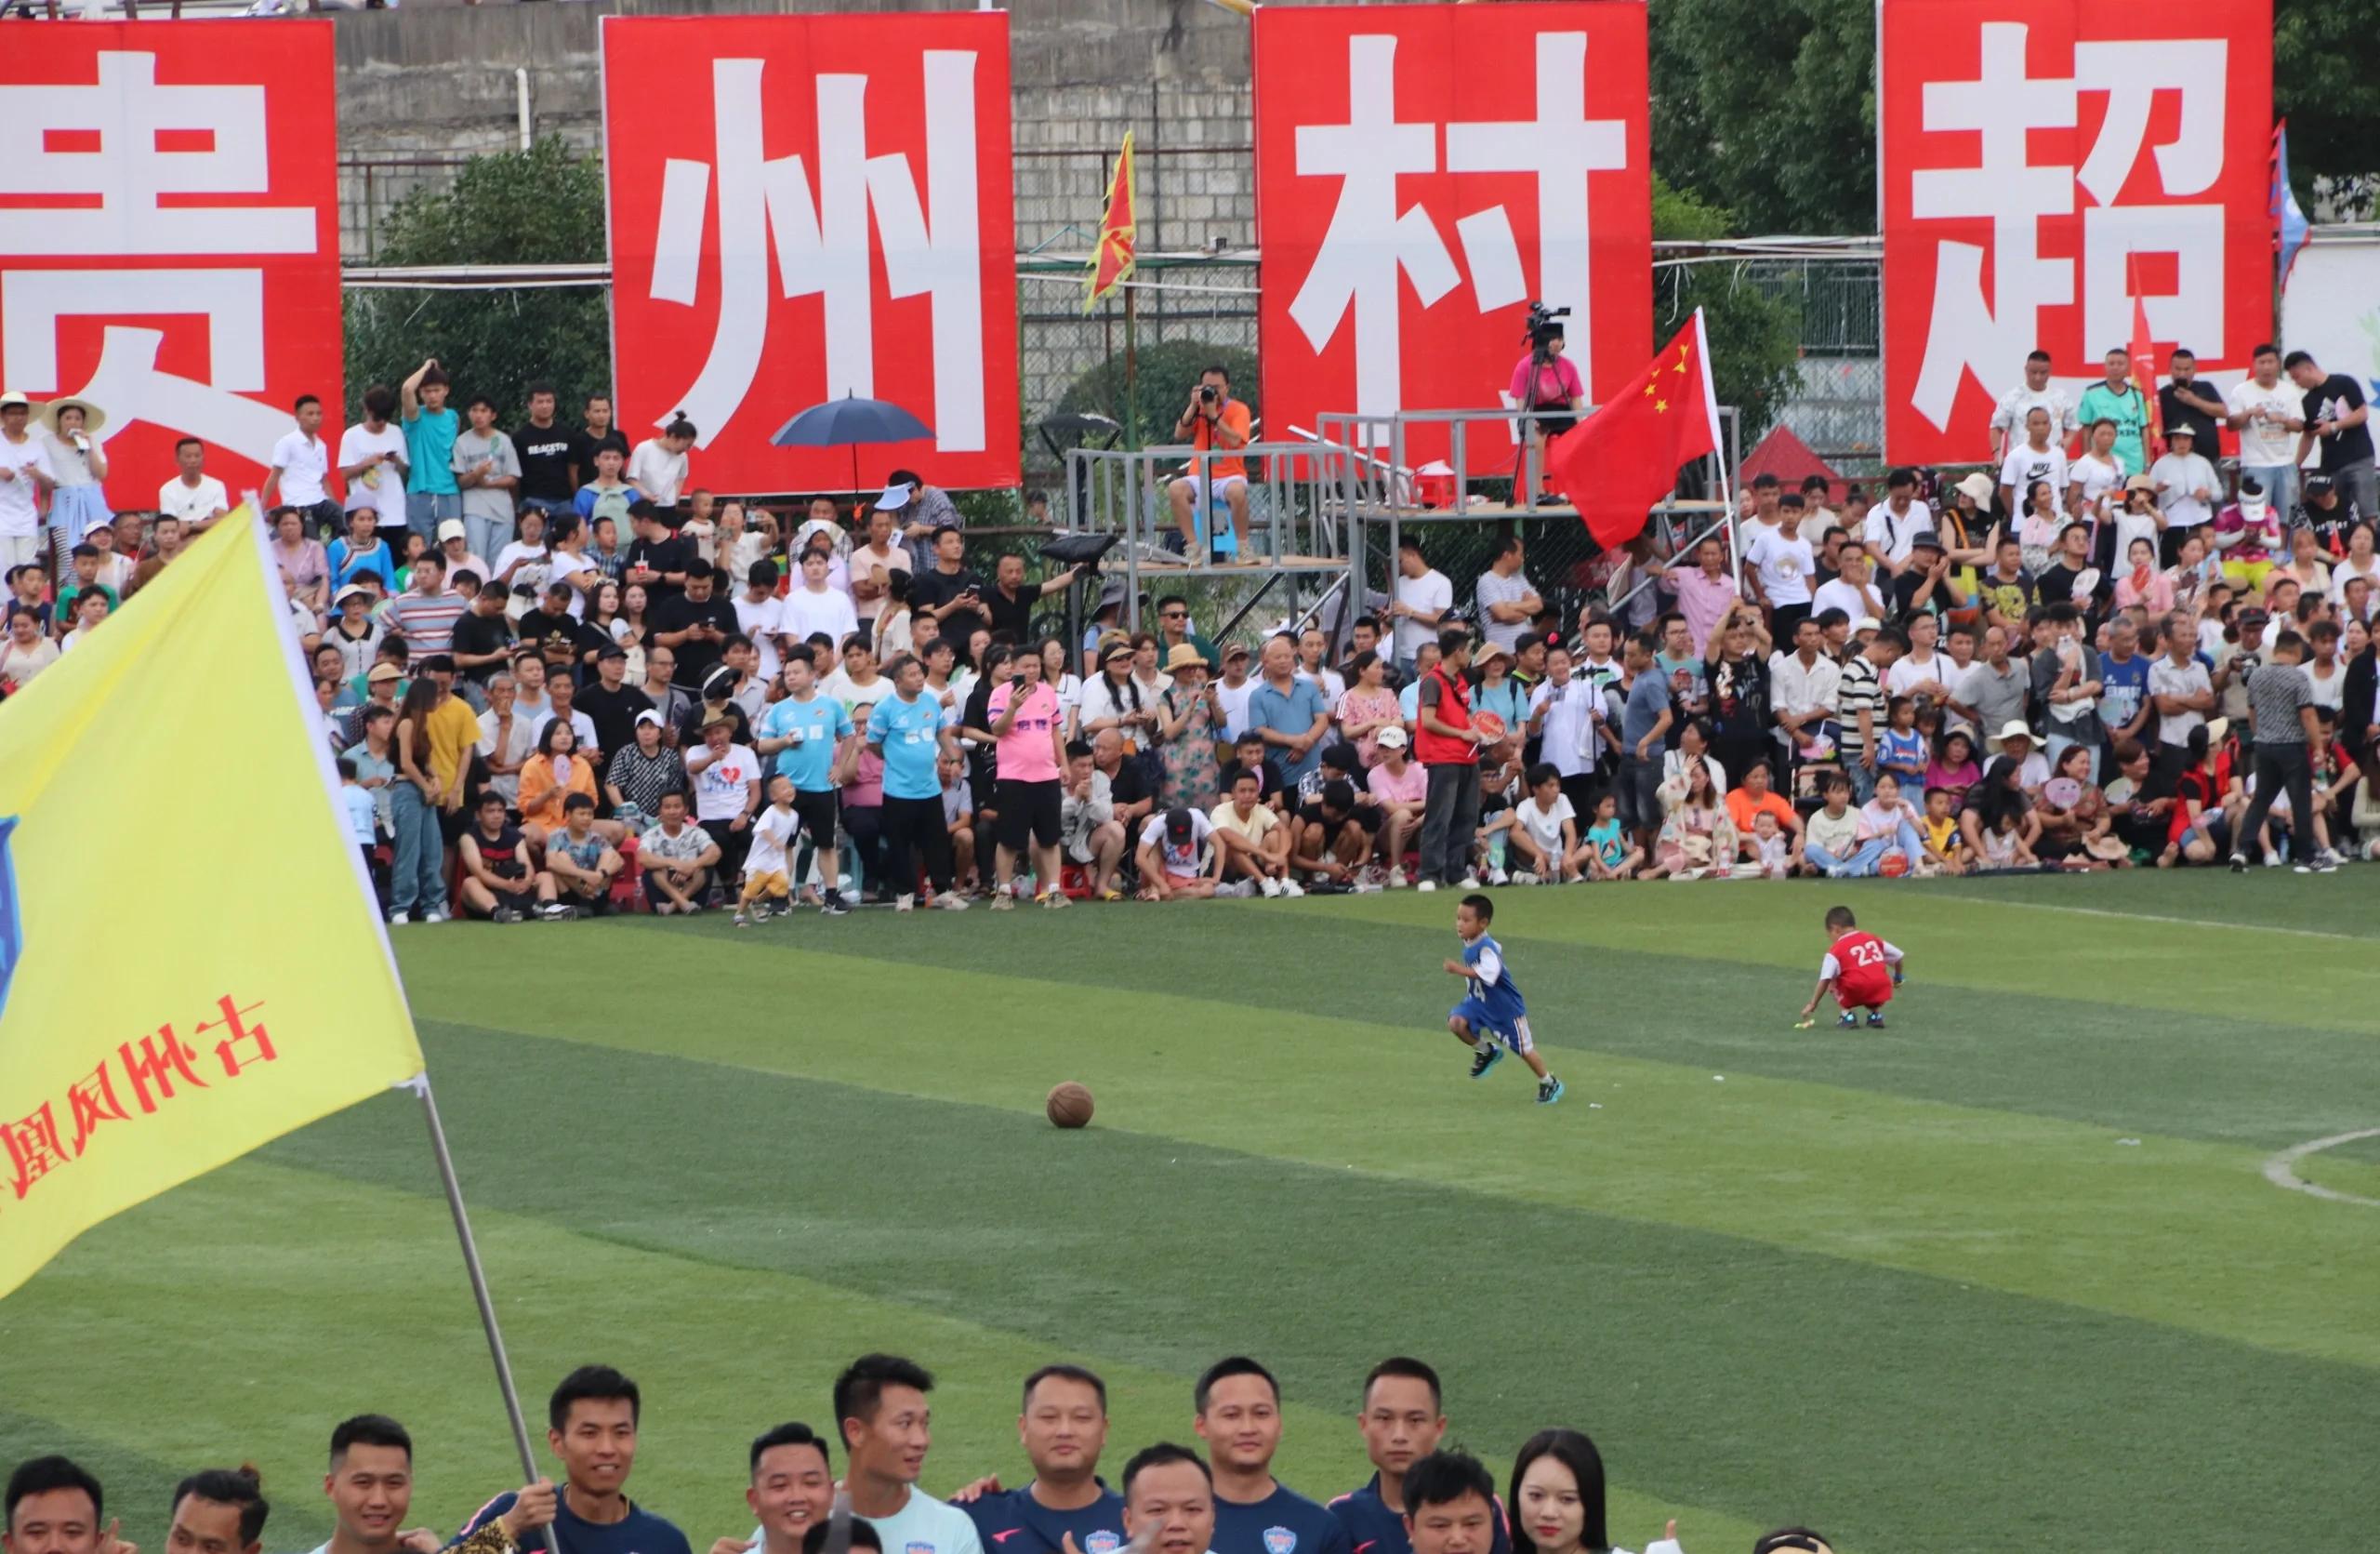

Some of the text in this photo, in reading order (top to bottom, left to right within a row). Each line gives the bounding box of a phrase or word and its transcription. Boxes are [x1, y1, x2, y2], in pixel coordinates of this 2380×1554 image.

[0, 50, 317, 468] 贵
[650, 49, 986, 453] 州
[1289, 31, 1627, 447] 村
[1911, 21, 2250, 435] 超
[2031, 461, 2052, 472] NIKE
[1849, 940, 1884, 967] 23
